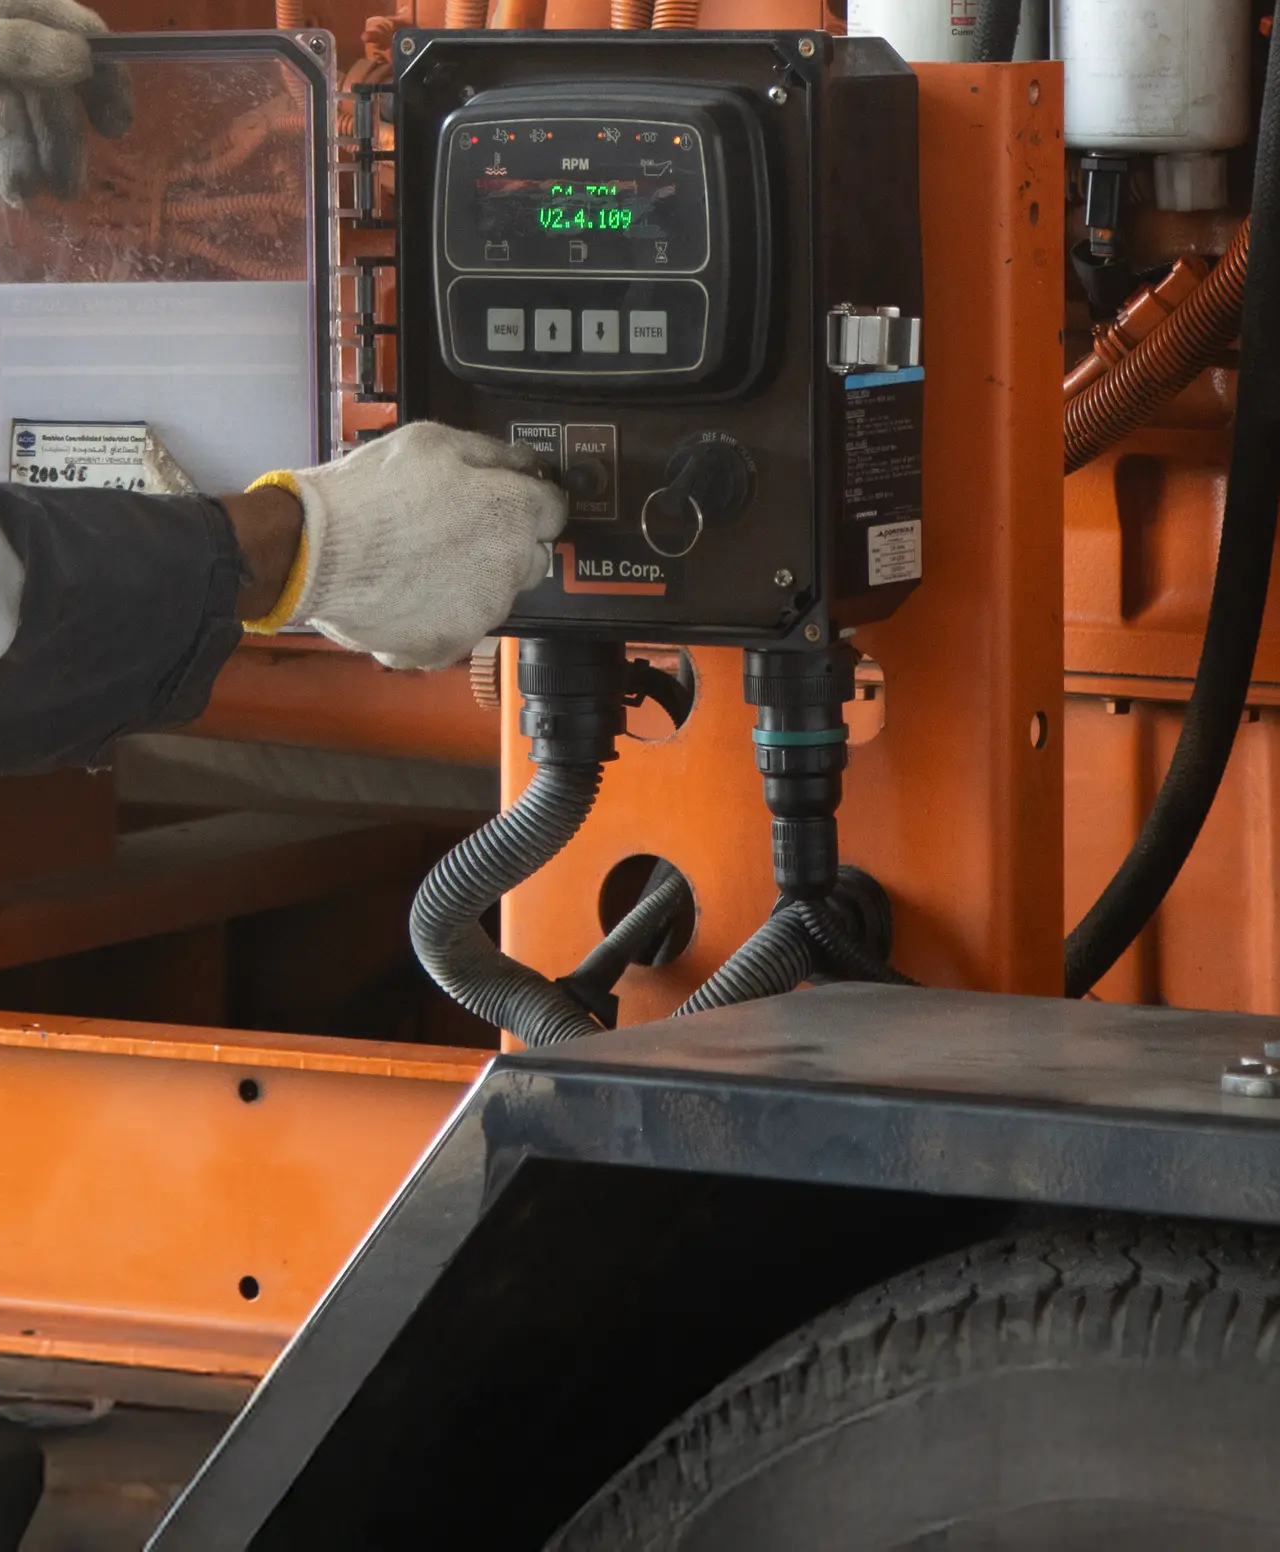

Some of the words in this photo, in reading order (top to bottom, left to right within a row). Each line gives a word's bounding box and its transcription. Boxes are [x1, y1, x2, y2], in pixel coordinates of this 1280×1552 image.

[562, 159, 589, 170] RPM
[540, 209, 632, 229] V2.4.109
[494, 325, 519, 335] MENU
[634, 327, 663, 338] ENTER
[517, 428, 557, 437] THROTTLE
[702, 432, 717, 442] OFF
[42, 434, 64, 442] Arabian
[530, 442, 554, 452] NUAL
[575, 443, 606, 453] FAULT
[576, 501, 609, 512] RESET
[578, 560, 614, 577] NLB
[619, 561, 665, 581] Corp.
